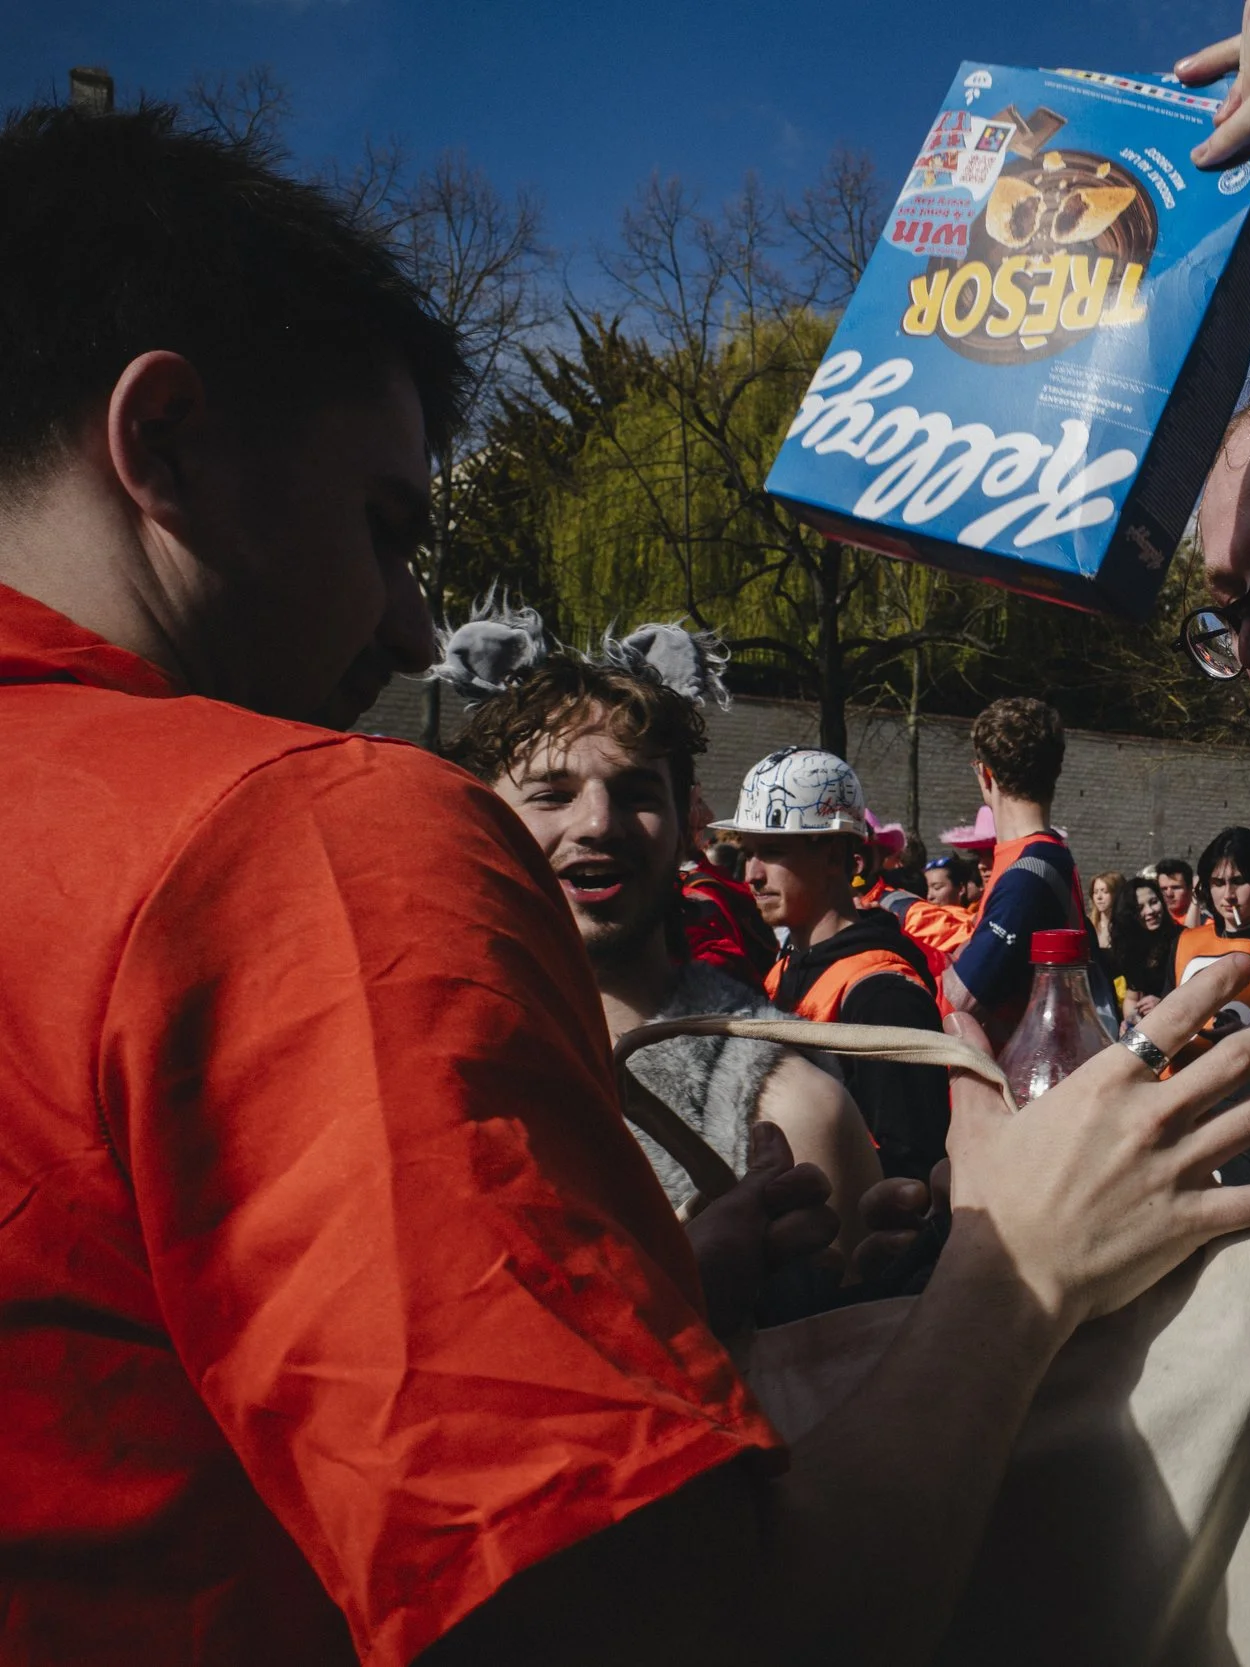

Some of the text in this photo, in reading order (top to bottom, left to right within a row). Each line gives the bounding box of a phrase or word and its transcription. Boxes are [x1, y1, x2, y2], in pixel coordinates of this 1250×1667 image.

[1119, 147, 1176, 210] CHOCOLAT AU LAIT
[1168, 169, 1187, 191] MILK
[892, 220, 968, 253] win
[902, 254, 1147, 350] TRÉSOR
